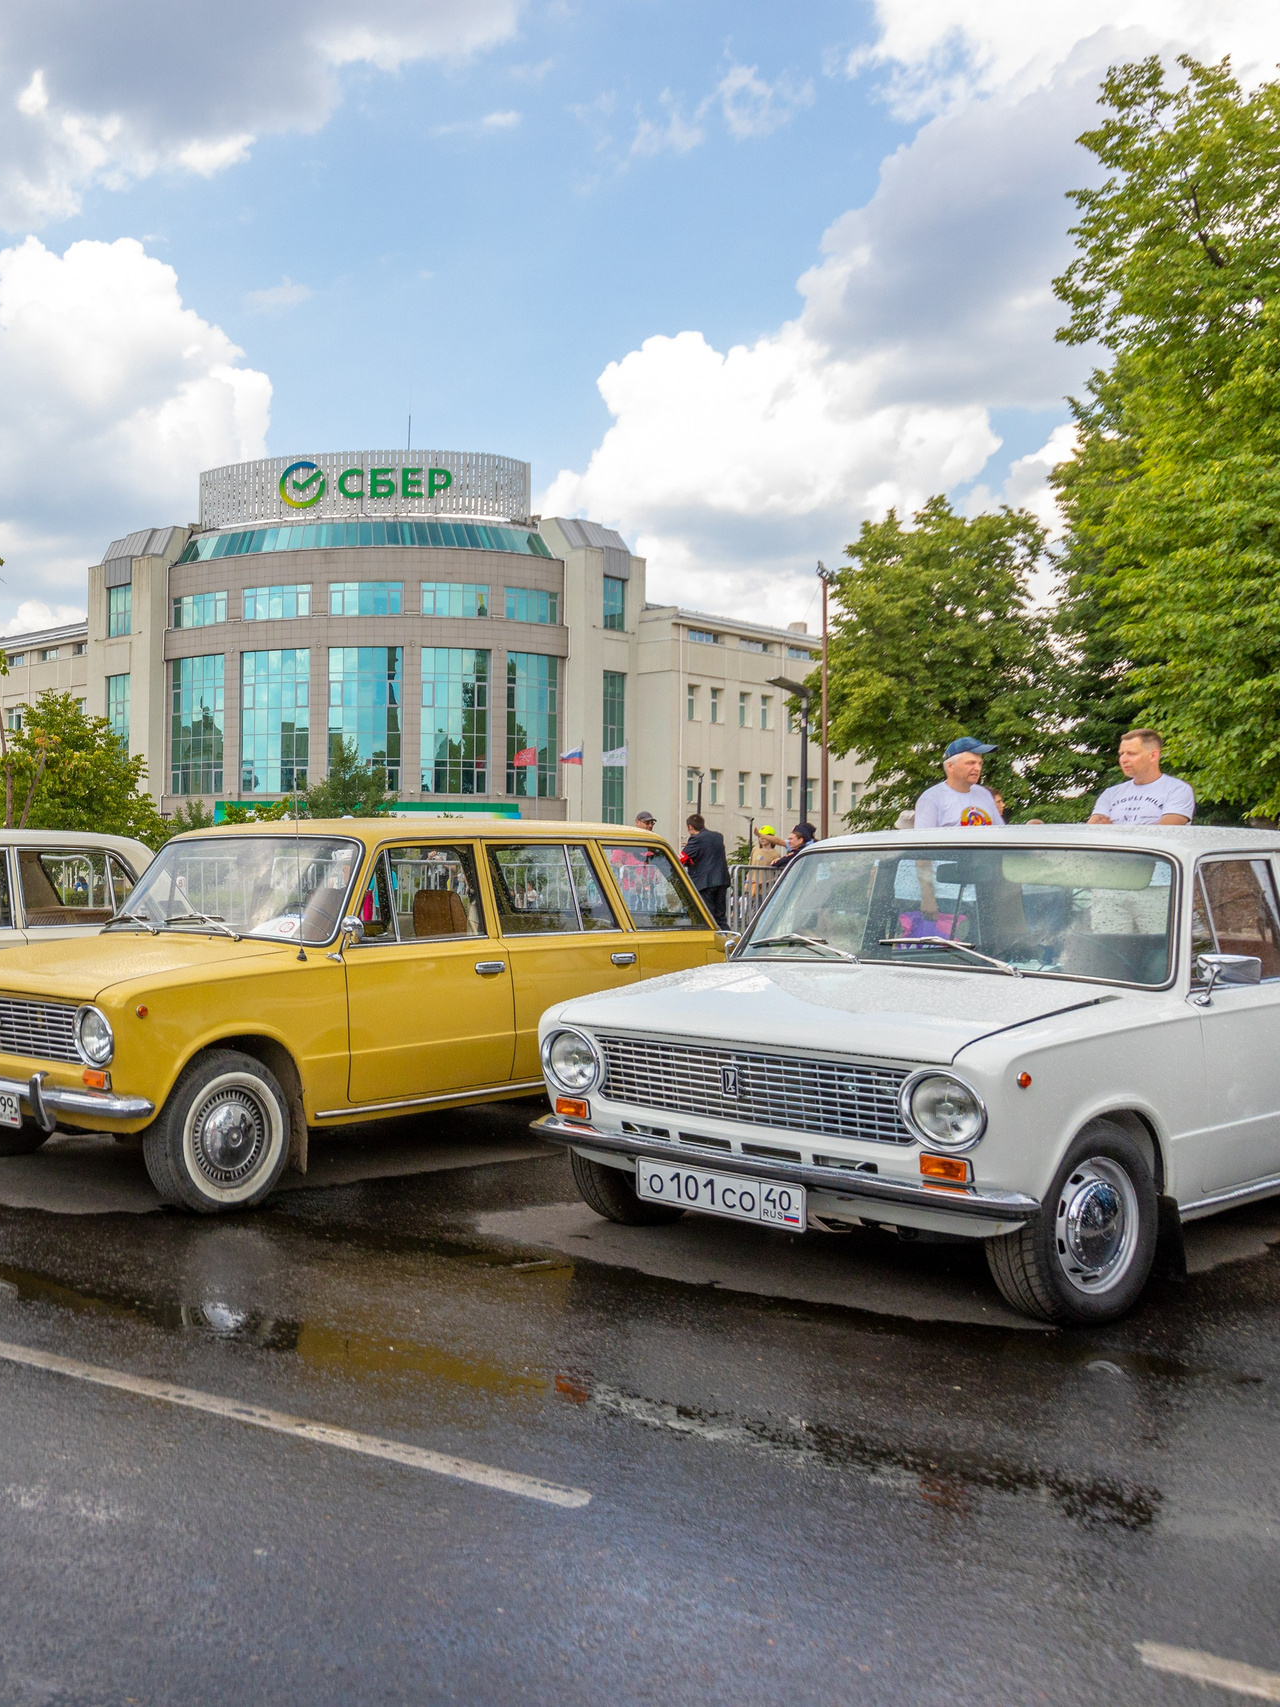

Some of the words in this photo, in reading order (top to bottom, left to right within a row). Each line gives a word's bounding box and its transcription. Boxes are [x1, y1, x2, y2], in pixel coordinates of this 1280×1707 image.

[338, 468, 453, 499] СБЕР
[764, 1188, 792, 1211] 40
[762, 1209, 784, 1220] RUS
